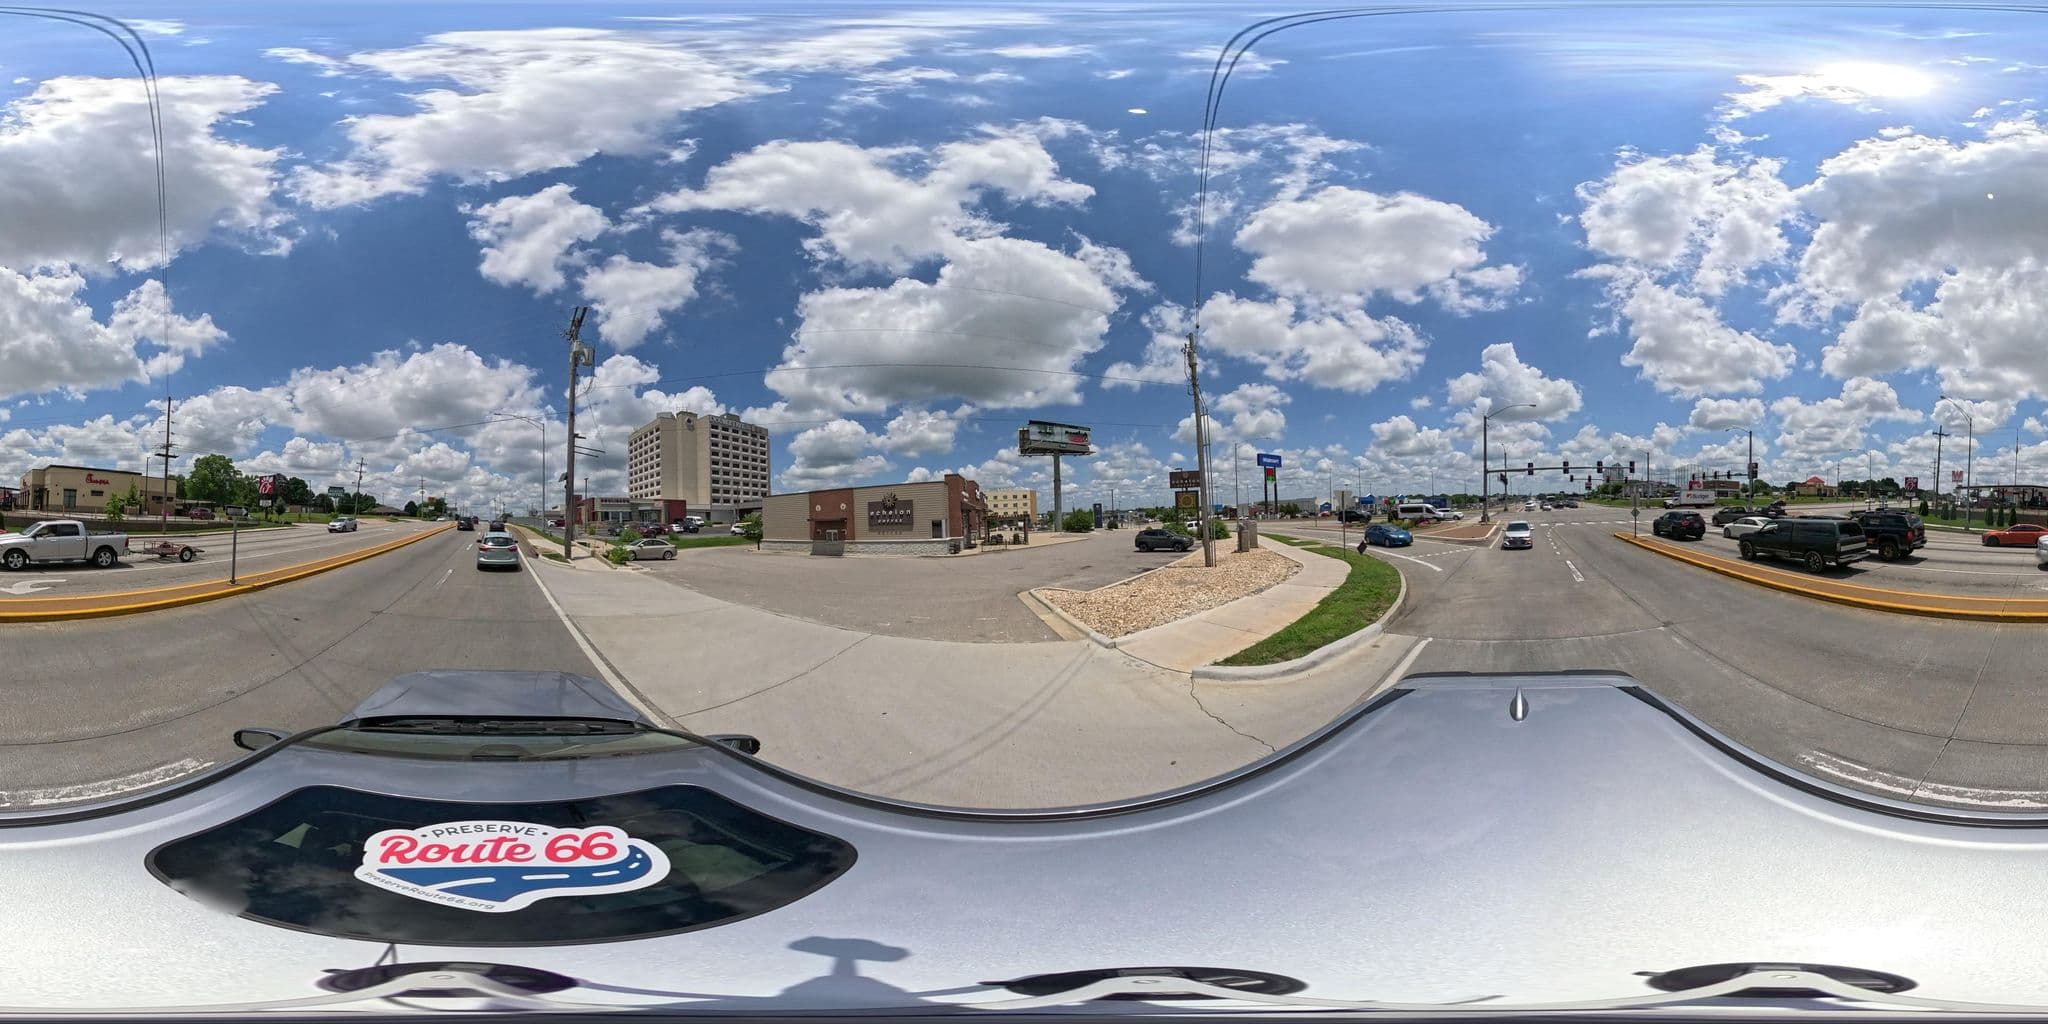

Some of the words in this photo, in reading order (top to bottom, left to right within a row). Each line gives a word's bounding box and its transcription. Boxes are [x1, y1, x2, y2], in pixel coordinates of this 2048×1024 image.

[431, 823, 539, 838] PRESERVE
[379, 834, 537, 865] Route
[544, 831, 618, 863] 66
[363, 871, 496, 911] PreserveRoute66.org
